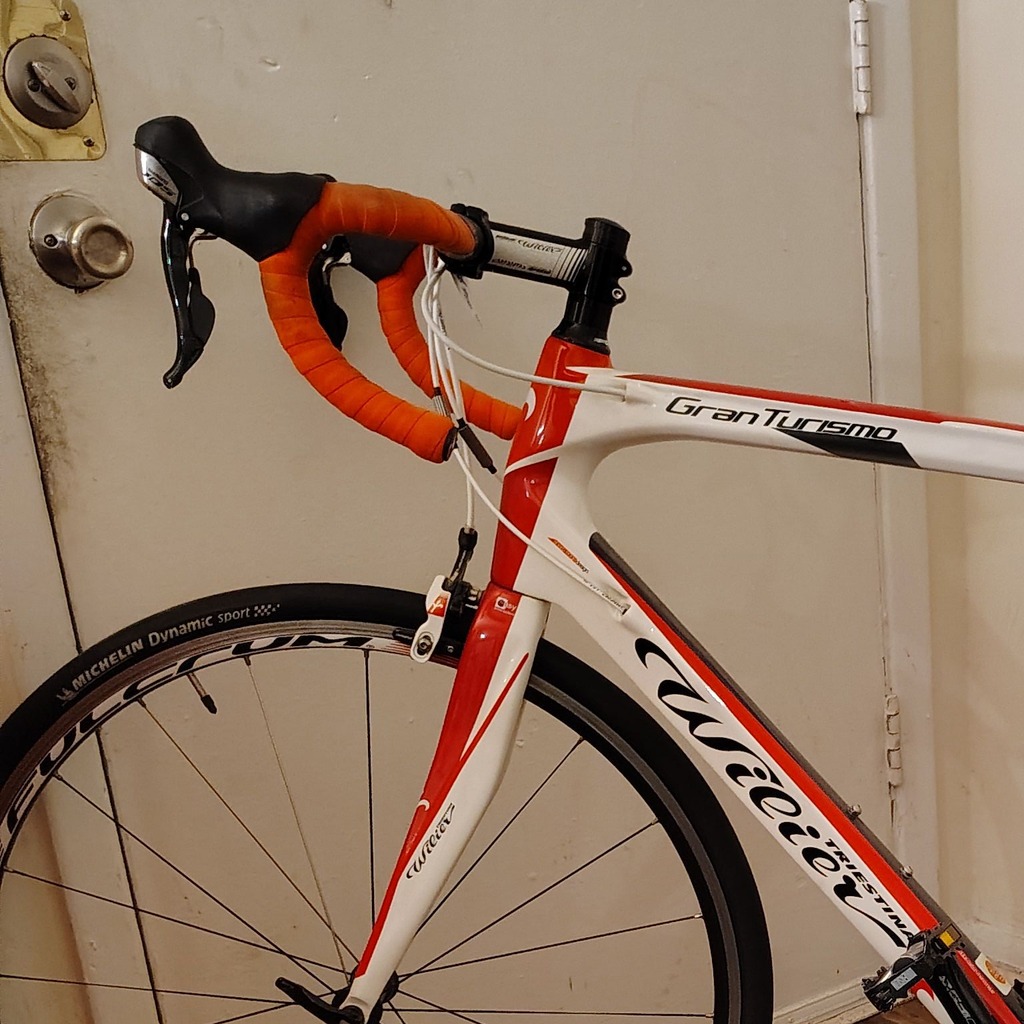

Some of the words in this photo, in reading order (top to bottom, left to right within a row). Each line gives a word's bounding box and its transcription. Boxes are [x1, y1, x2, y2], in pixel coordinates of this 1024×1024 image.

[71, 638, 144, 691] MICHELIN
[147, 615, 214, 647] Dynamic
[217, 607, 251, 624] sport
